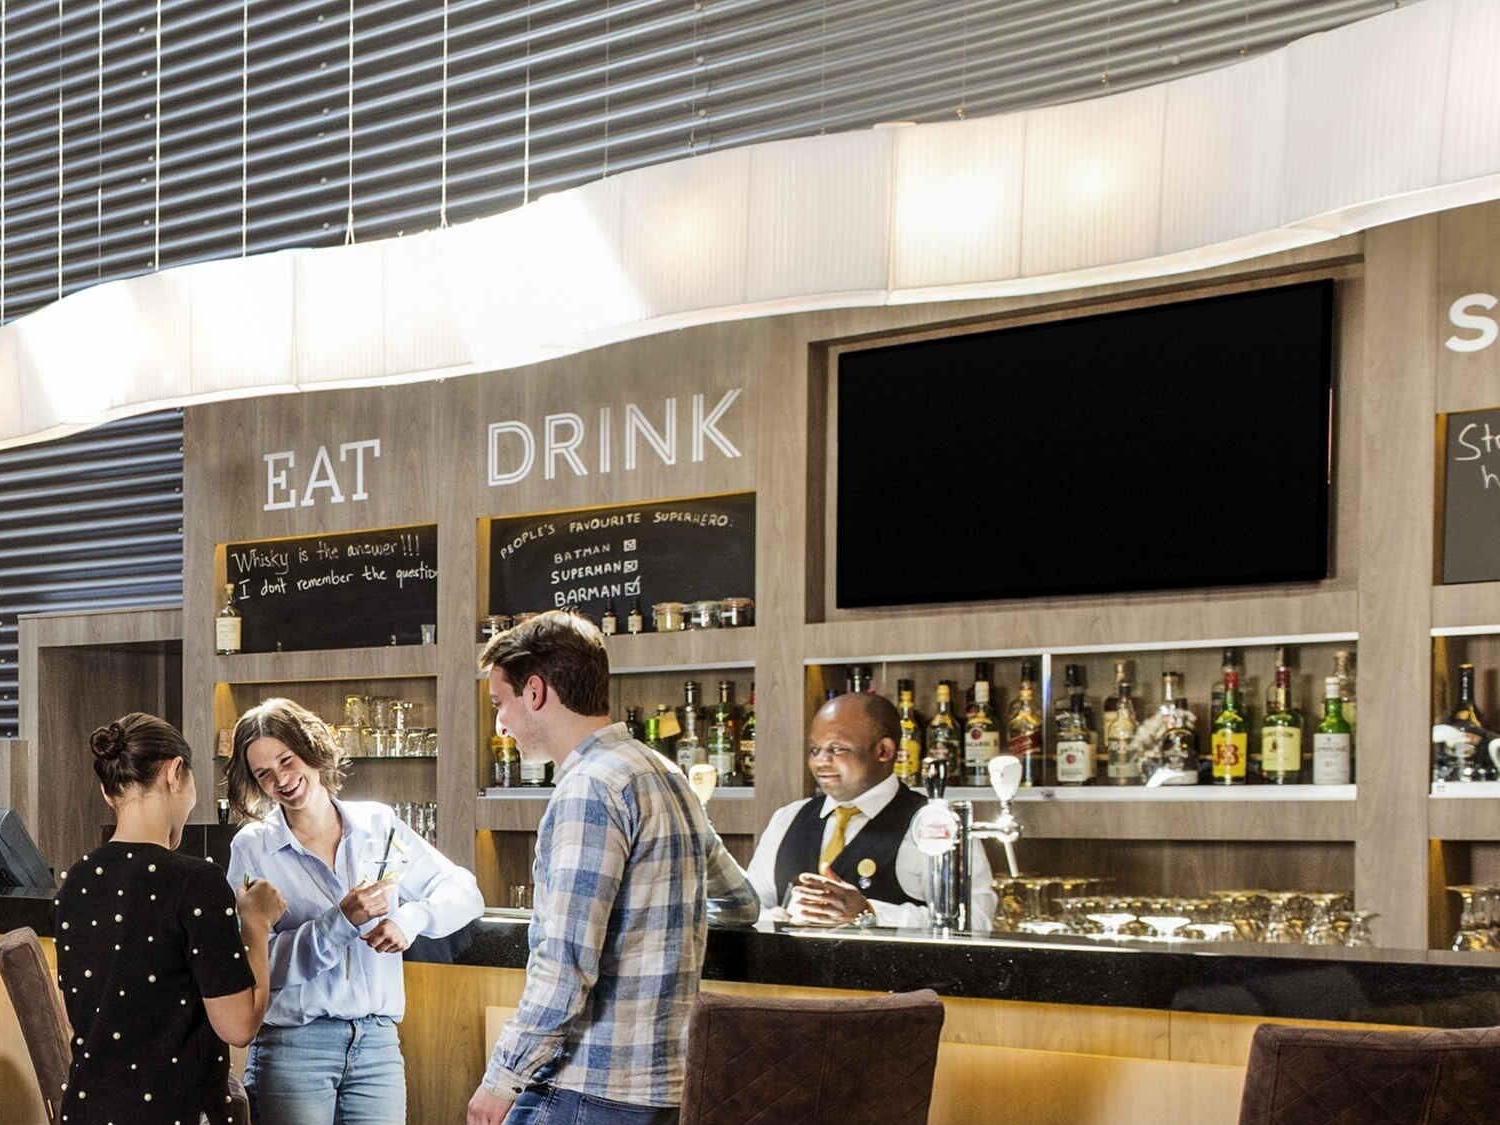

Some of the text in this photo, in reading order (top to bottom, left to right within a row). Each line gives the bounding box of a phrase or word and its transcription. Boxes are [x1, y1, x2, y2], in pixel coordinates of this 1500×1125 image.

[486, 387, 742, 488] DRINK
[263, 438, 381, 512] EAT
[500, 523, 556, 559] PEOPLE'S
[569, 512, 641, 534] FAVOURITE
[231, 549, 290, 576] Whisky
[298, 547, 309, 564] is
[316, 541, 339, 560] the
[553, 543, 611, 565] BATMAN
[239, 578, 250, 600] I
[296, 569, 354, 592] remember
[361, 565, 388, 580] the
[550, 560, 621, 585] SUPERMAN
[554, 584, 621, 608] BARMAN
